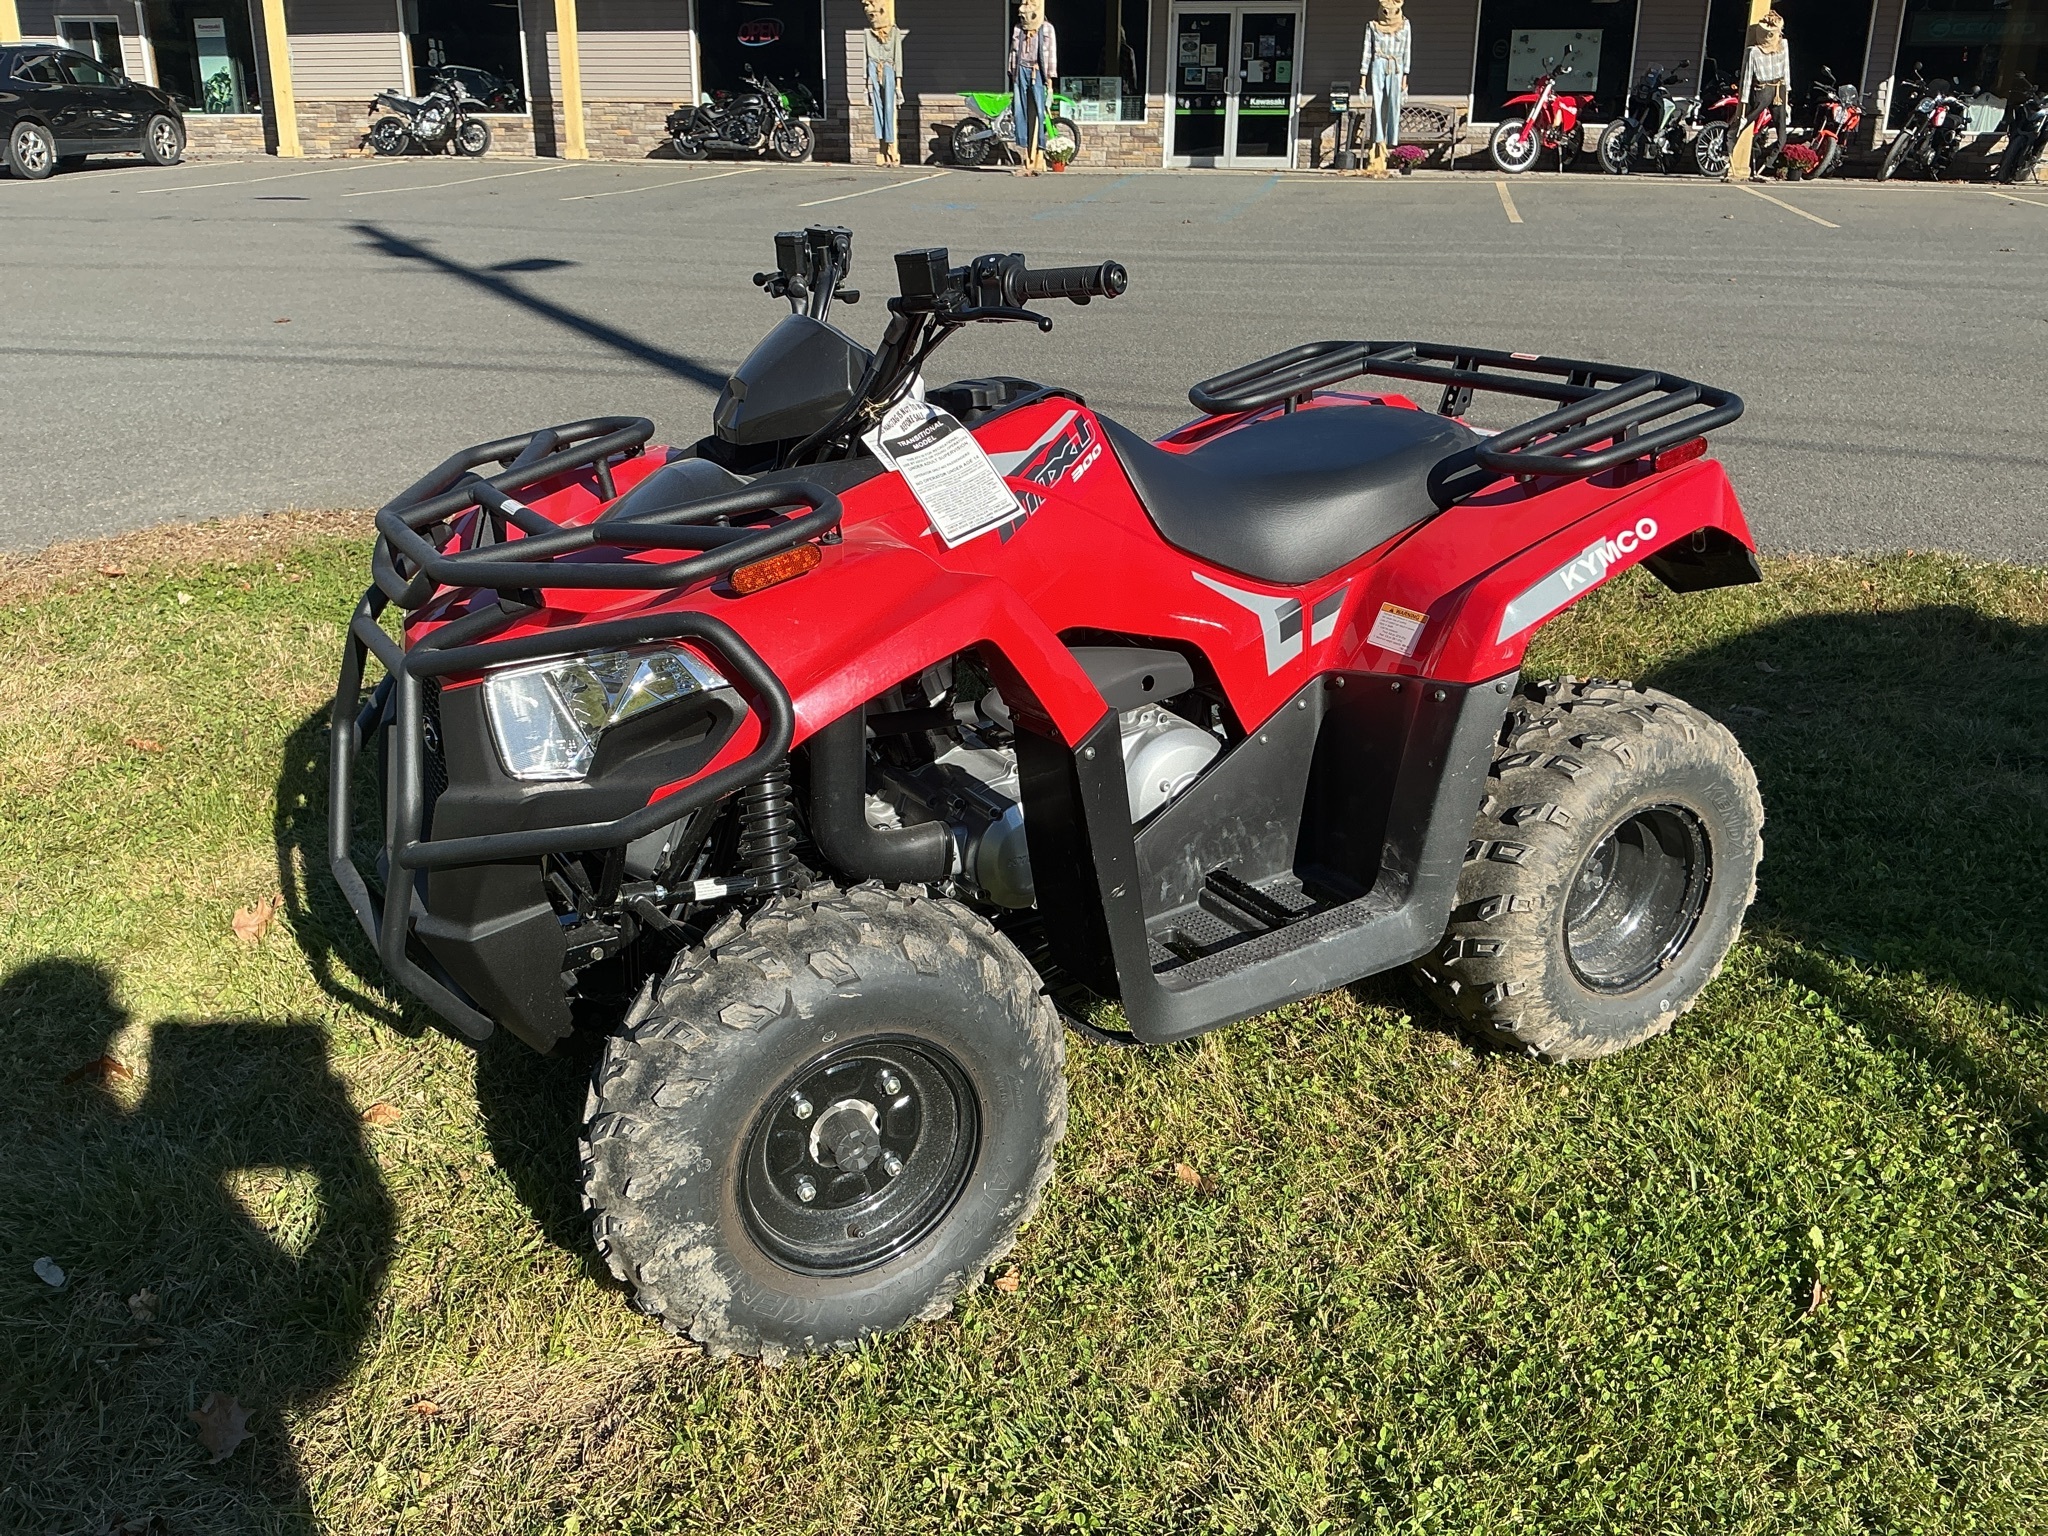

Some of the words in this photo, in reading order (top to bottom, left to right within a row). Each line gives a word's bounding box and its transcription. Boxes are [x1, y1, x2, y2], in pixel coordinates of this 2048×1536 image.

[739, 22, 779, 41] OPEN
[1250, 98, 1286, 106] Kawasaki
[897, 421, 943, 446] TRANSITIONAL
[912, 435, 936, 449] MODEL
[1071, 443, 1102, 483] 300
[1560, 518, 1658, 591] KYMCO
[1700, 782, 1744, 860] KENDA
